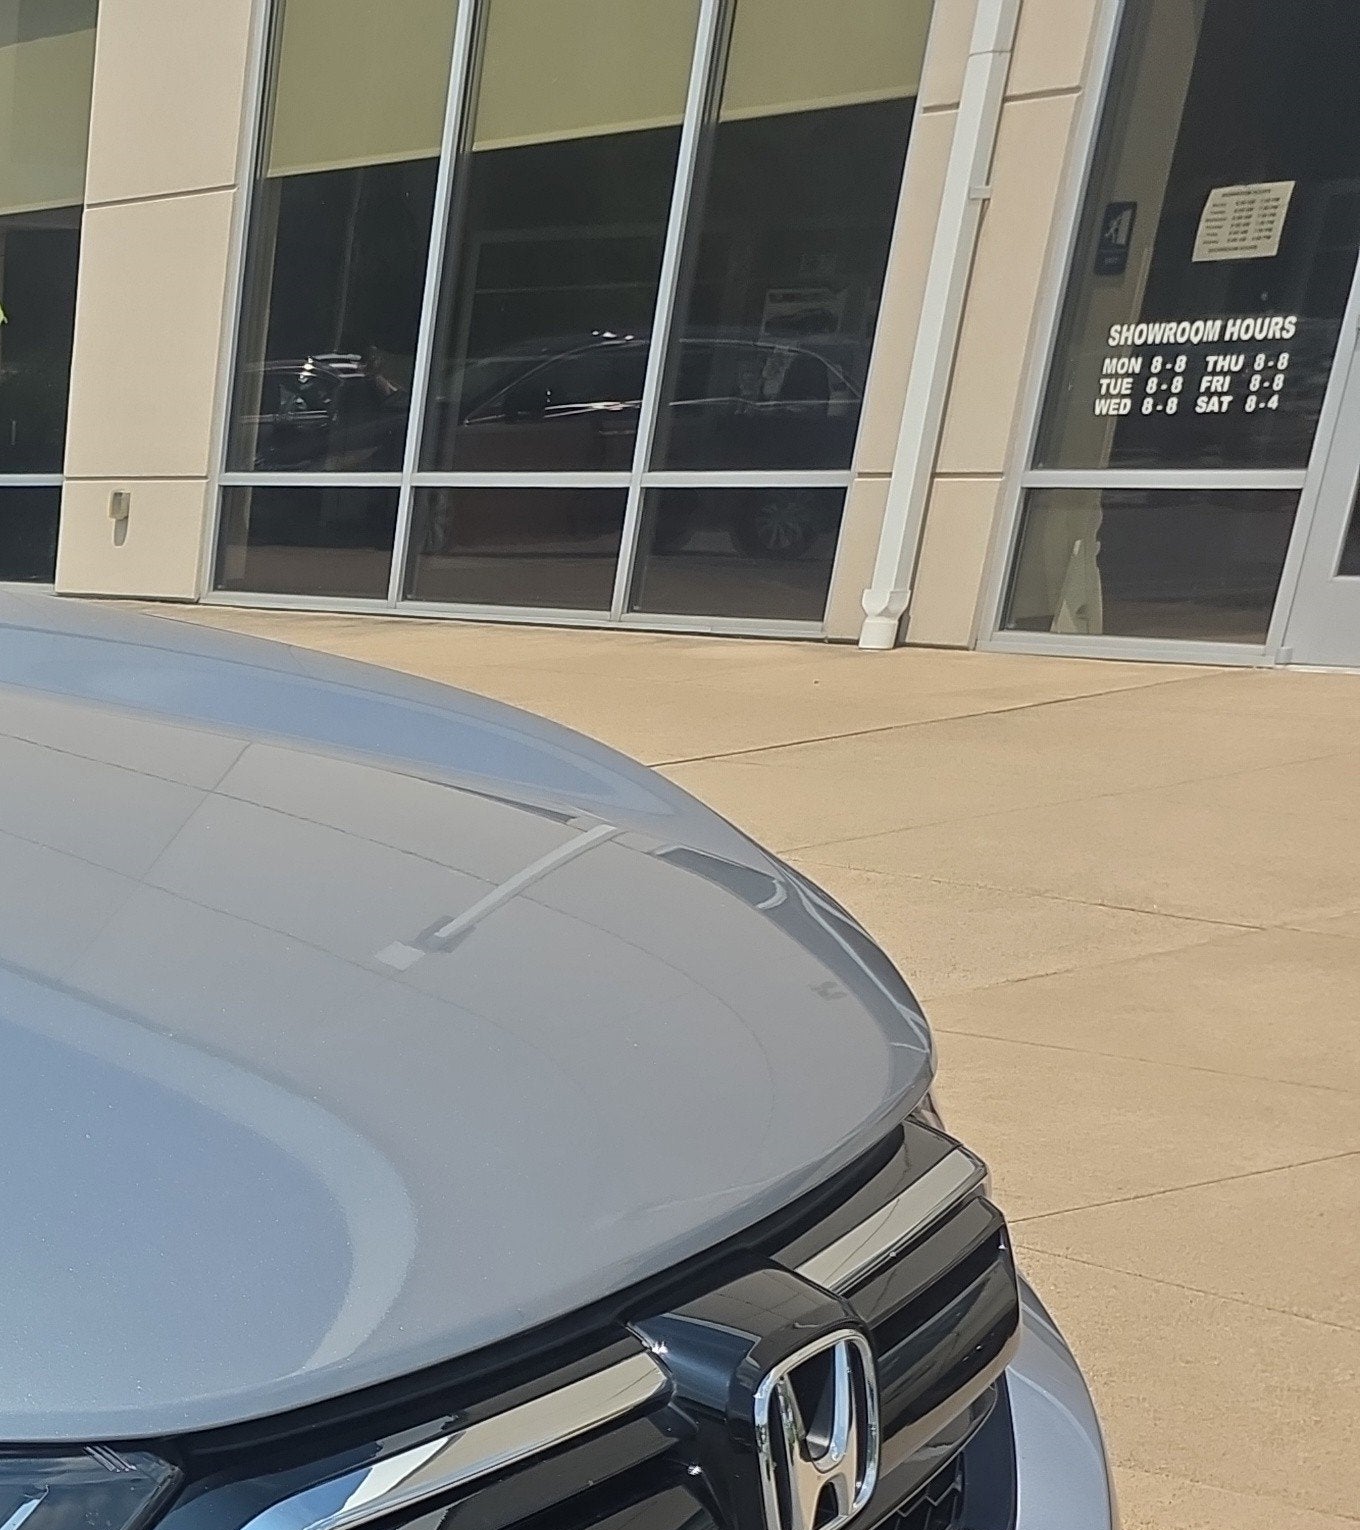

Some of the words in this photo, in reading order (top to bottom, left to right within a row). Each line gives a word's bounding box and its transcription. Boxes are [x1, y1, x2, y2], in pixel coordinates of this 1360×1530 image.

[1107, 320, 1223, 347] SHOWROOM
[1224, 316, 1298, 342] HOURS
[1102, 356, 1143, 374] MON
[1205, 354, 1245, 372] THU
[1099, 378, 1134, 395] TUE
[1199, 375, 1231, 392] FRI
[1094, 398, 1131, 416] WED
[1195, 395, 1234, 413] SAT
